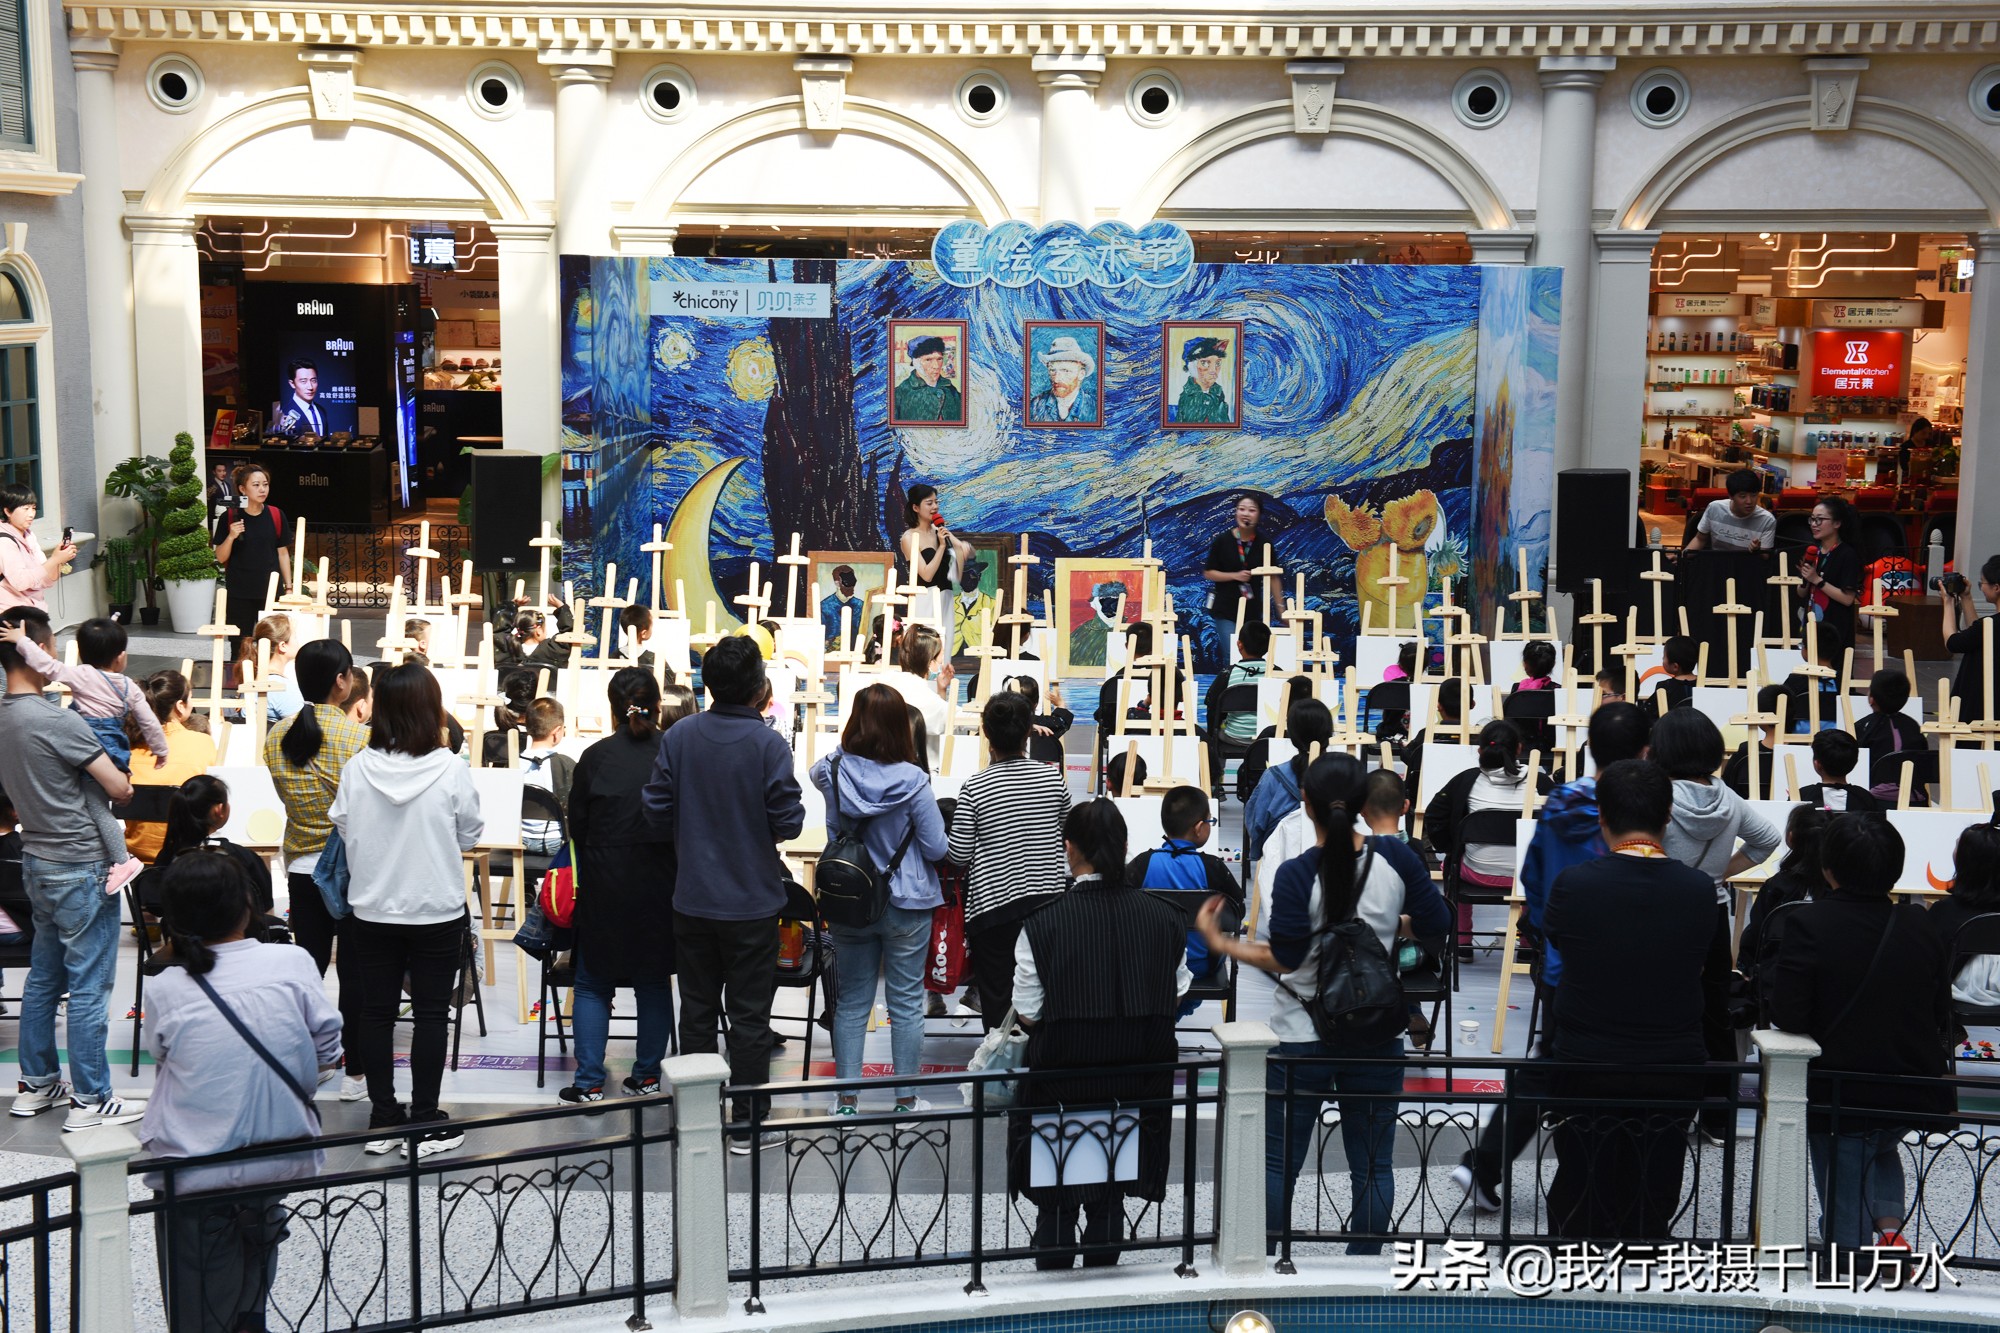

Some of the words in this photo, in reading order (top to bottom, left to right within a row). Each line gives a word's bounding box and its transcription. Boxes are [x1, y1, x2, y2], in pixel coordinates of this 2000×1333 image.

[950, 237, 1179, 273] 童绘艺术节
[712, 289, 739, 297] 群光广场
[297, 299, 334, 315] BRAUN
[679, 293, 738, 312] chicony
[1847, 307, 1874, 316] 居元素
[325, 338, 354, 351] BRAUN
[1821, 367, 1890, 376] ElementalKitchen
[1834, 377, 1874, 390] 居元素
[299, 473, 329, 487] BRAUN
